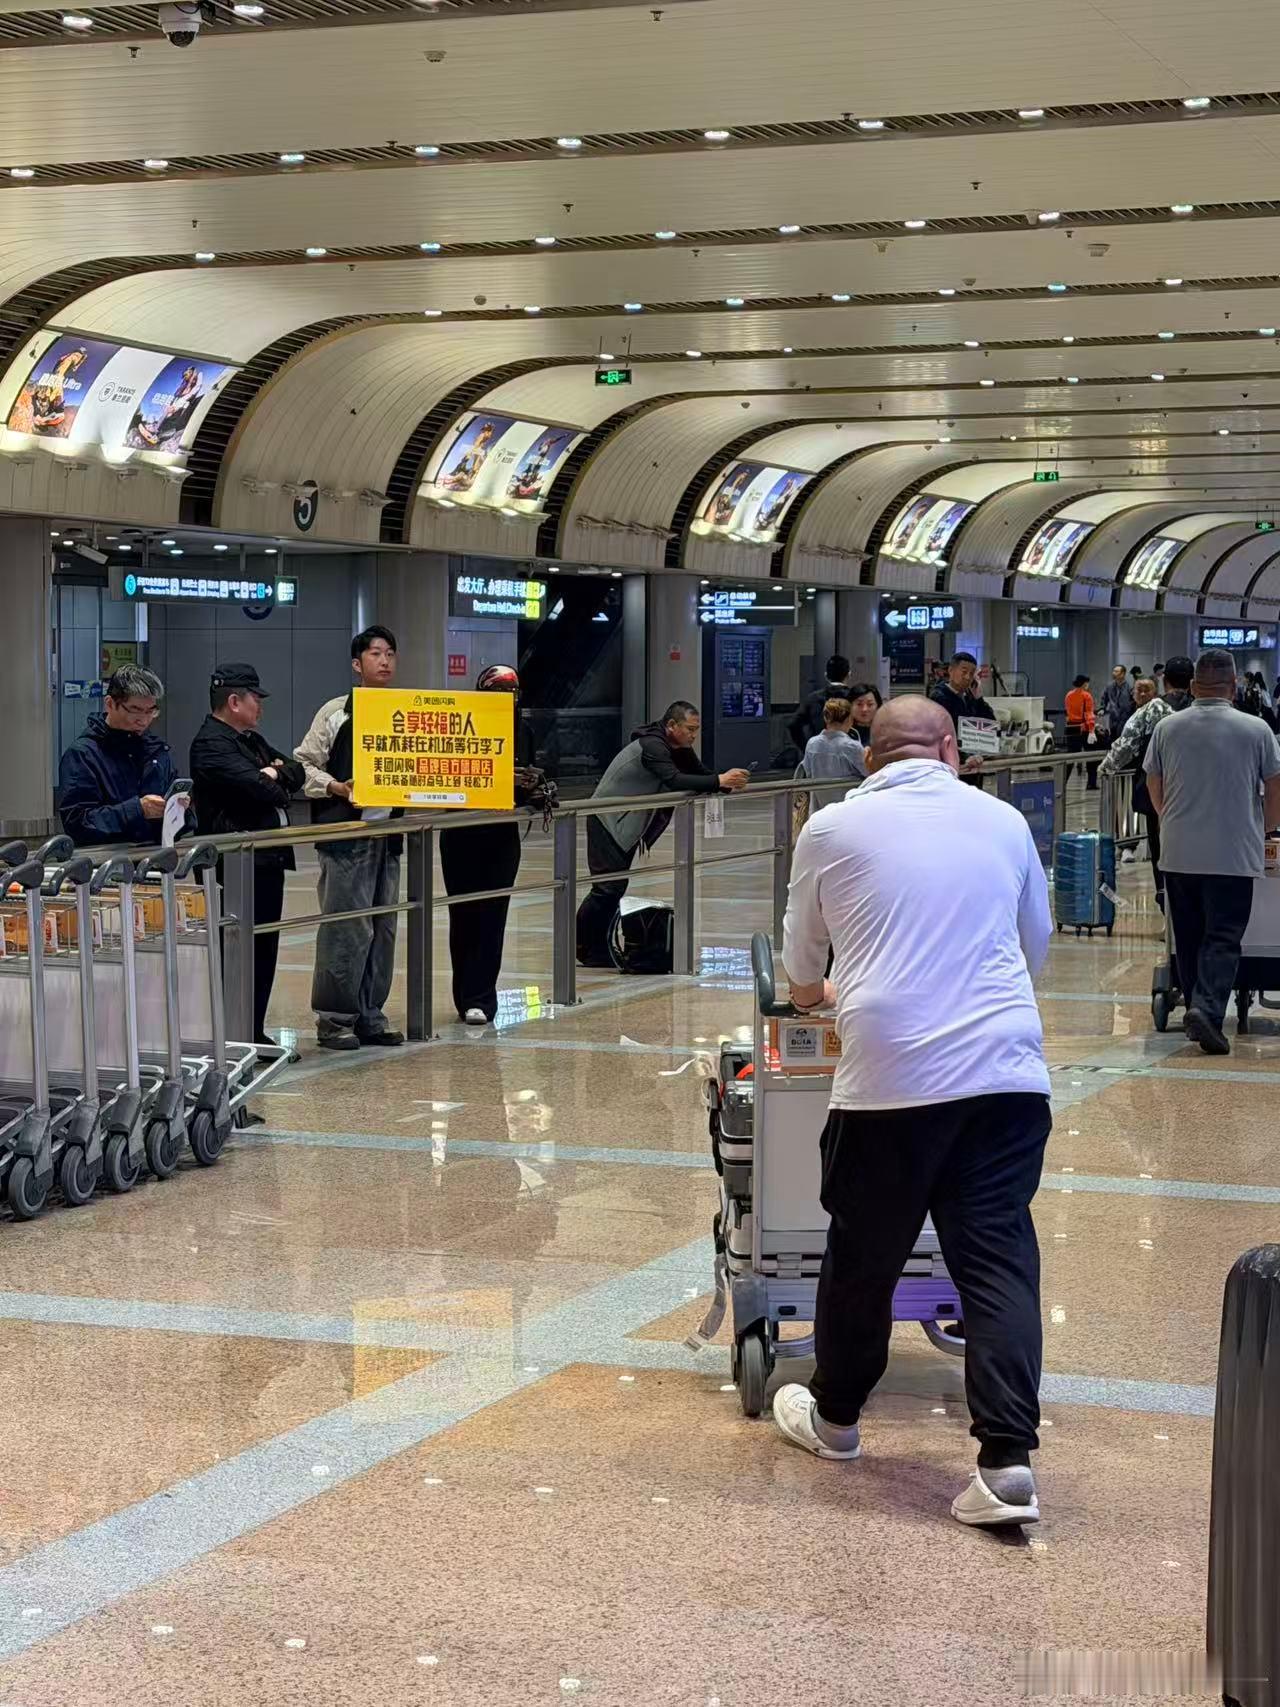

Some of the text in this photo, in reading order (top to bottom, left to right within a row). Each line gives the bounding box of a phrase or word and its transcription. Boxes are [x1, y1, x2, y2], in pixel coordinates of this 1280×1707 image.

[423, 696, 456, 706] 美团闪购
[392, 710, 476, 736] 会享轻福的人
[362, 735, 505, 755] 早就不耗在机场等行李了
[374, 757, 492, 775] 美团闪购 品牌官方旗舰店
